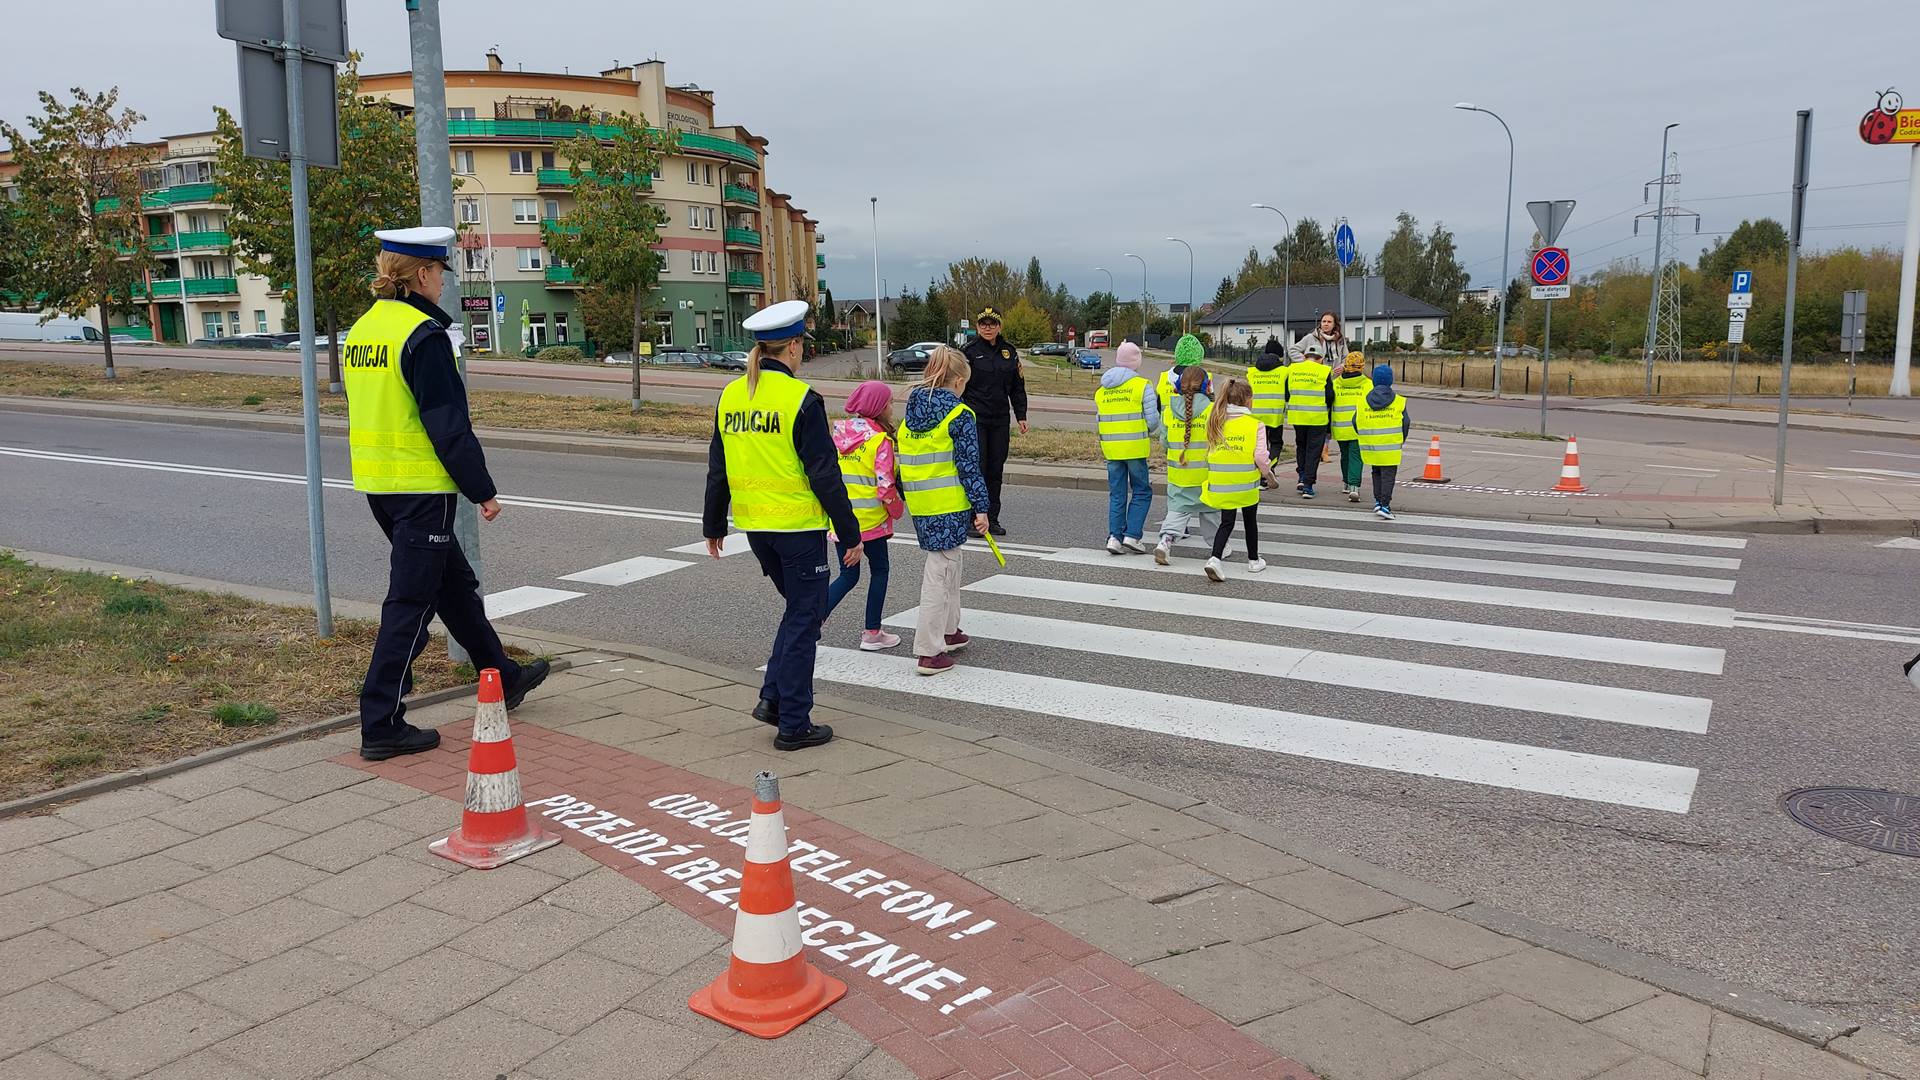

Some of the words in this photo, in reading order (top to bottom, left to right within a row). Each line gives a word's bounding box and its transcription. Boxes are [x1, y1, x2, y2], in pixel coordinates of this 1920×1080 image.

[1736, 273, 1748, 291] P
[344, 344, 388, 368] POLICJA
[724, 410, 781, 434] POLICJA
[524, 794, 706, 866] PRZEJDŹ
